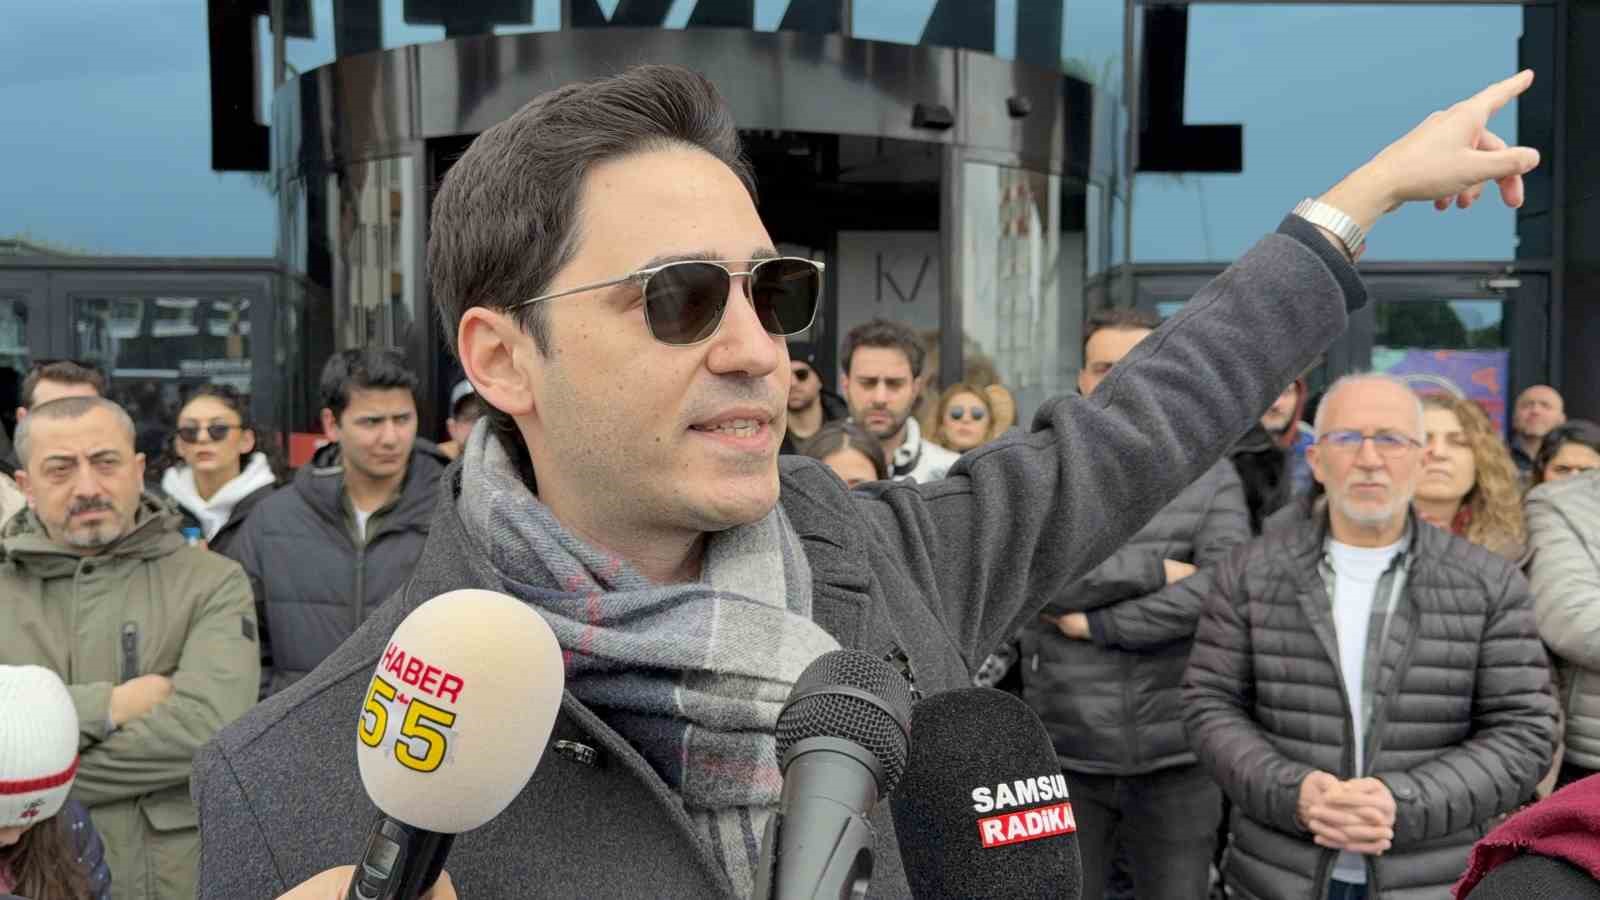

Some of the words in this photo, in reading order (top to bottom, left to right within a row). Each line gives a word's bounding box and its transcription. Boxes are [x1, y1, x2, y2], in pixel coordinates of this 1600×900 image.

[382, 642, 465, 704] HABER
[358, 674, 457, 773] 55
[971, 774, 1070, 813] SAMSU
